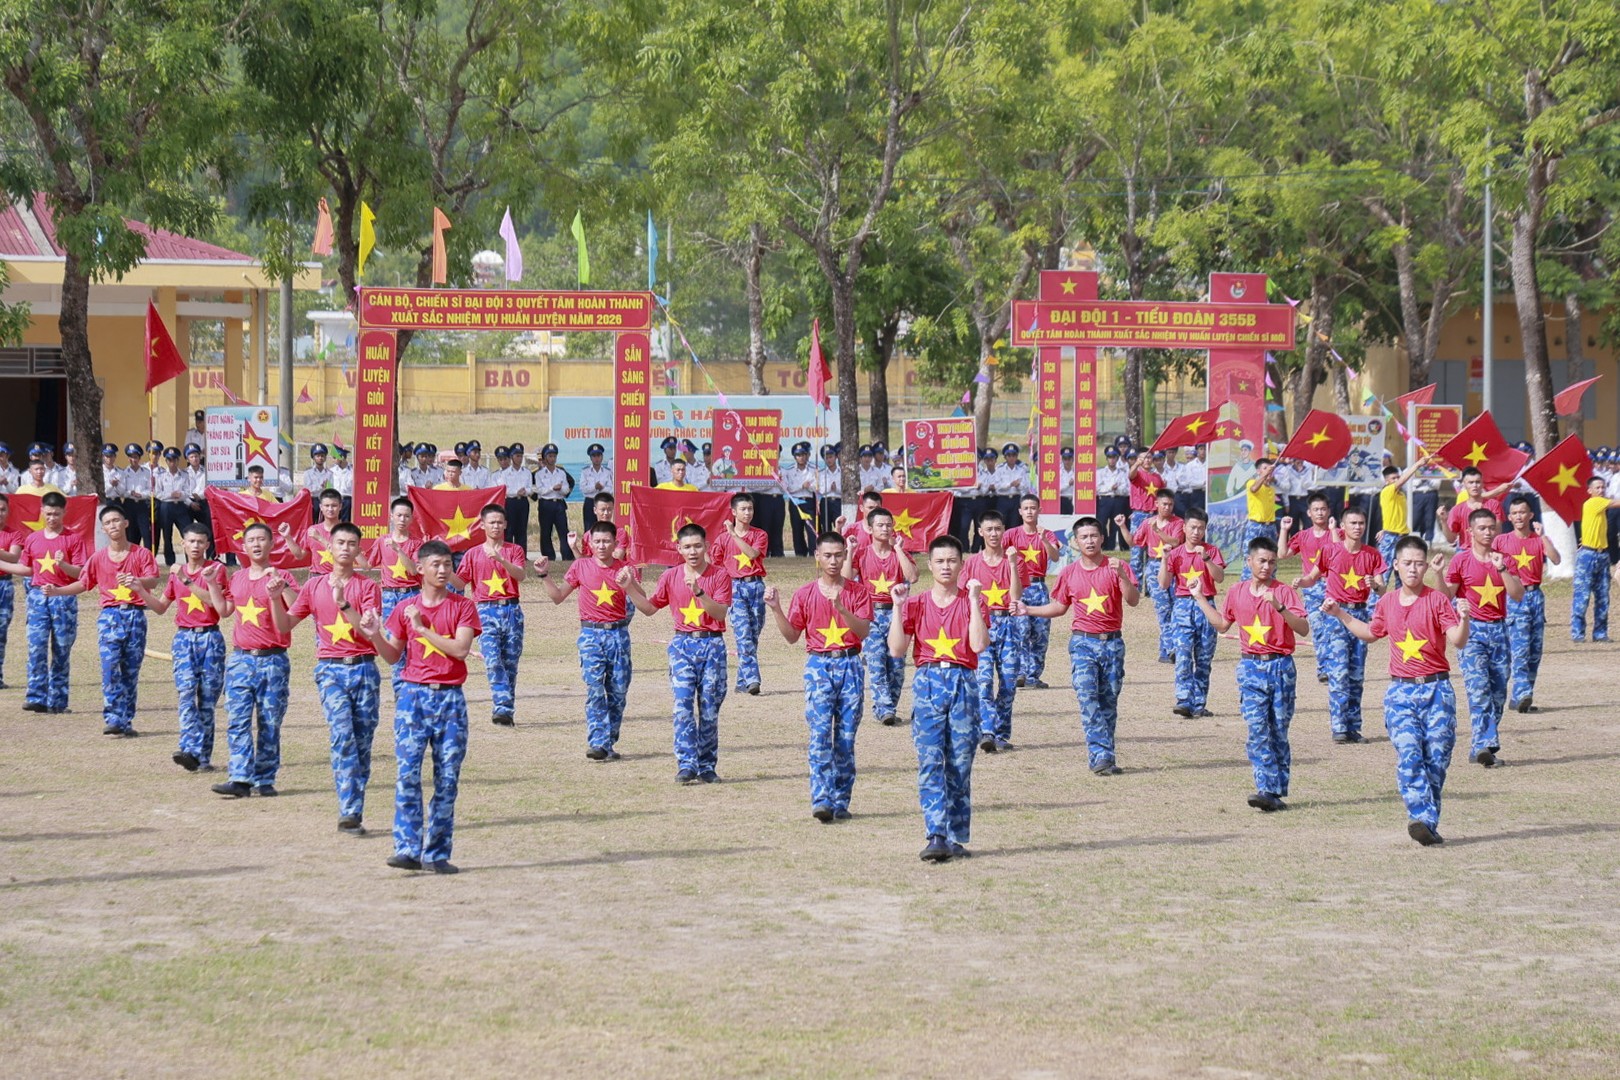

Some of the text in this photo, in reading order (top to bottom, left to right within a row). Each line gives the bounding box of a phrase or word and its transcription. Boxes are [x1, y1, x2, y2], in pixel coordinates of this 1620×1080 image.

[369, 293, 392, 306] CÁN
[416, 293, 448, 308] CHIẾN
[451, 295, 462, 308] SĨ
[465, 296, 483, 310] ĐẠI
[485, 295, 503, 310] ĐỘI
[506, 297, 513, 308] 3
[516, 295, 549, 308] QUYẾT
[552, 296, 574, 308] TÂM
[578, 296, 606, 309] HOÀN
[609, 296, 643, 309] THÀNH
[391, 308, 622, 327] XUẤT SẮC NHIỆM VỤ HUẤN LUYỆN NĂM 2026
[1050, 310, 1076, 325] ĐẠI
[1081, 308, 1106, 325] ĐỘI
[1112, 311, 1118, 323] 1
[1135, 305, 1168, 324] TIỂU
[1173, 310, 1215, 325] ĐOÀN
[1219, 313, 1256, 326] 355B
[366, 342, 389, 360] HUẤN
[363, 366, 390, 386] LUYỆN
[622, 367, 644, 384] SÀNG
[367, 387, 384, 405] GIỎI
[621, 389, 645, 406] CHIẾN
[362, 411, 387, 428] ĐOÀN
[624, 410, 641, 428] ĐẤU
[691, 406, 713, 420] HẢ
[366, 432, 382, 450] KẾT
[624, 436, 640, 450] CAO
[365, 454, 381, 472] TỐT
[626, 459, 638, 472] AN
[366, 477, 378, 495] KỶ
[361, 501, 382, 520] LUẬT
[358, 523, 388, 539] GHIÊM
